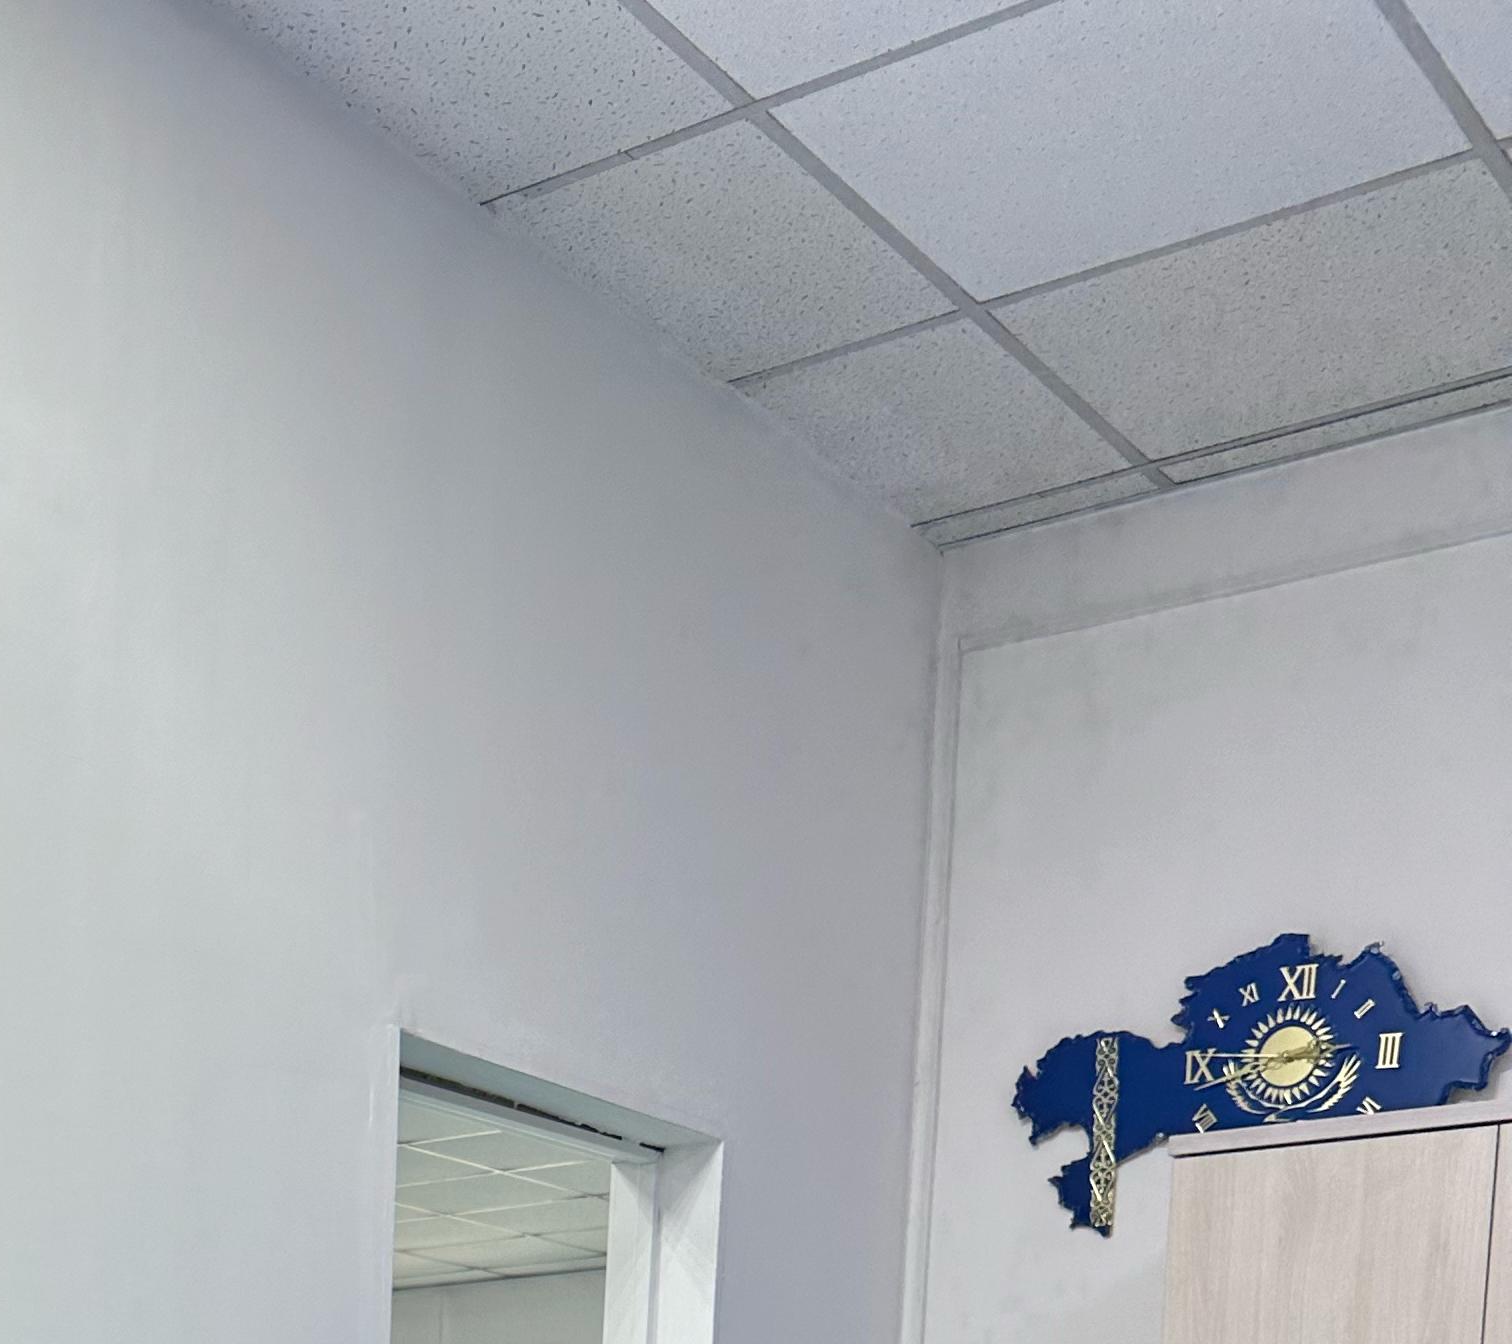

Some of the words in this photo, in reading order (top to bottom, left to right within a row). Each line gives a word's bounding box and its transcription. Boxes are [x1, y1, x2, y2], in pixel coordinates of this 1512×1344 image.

[1277, 964, 1319, 1001] XII
[1184, 1048, 1217, 1085] IX
[1375, 1032, 1405, 1069] III
